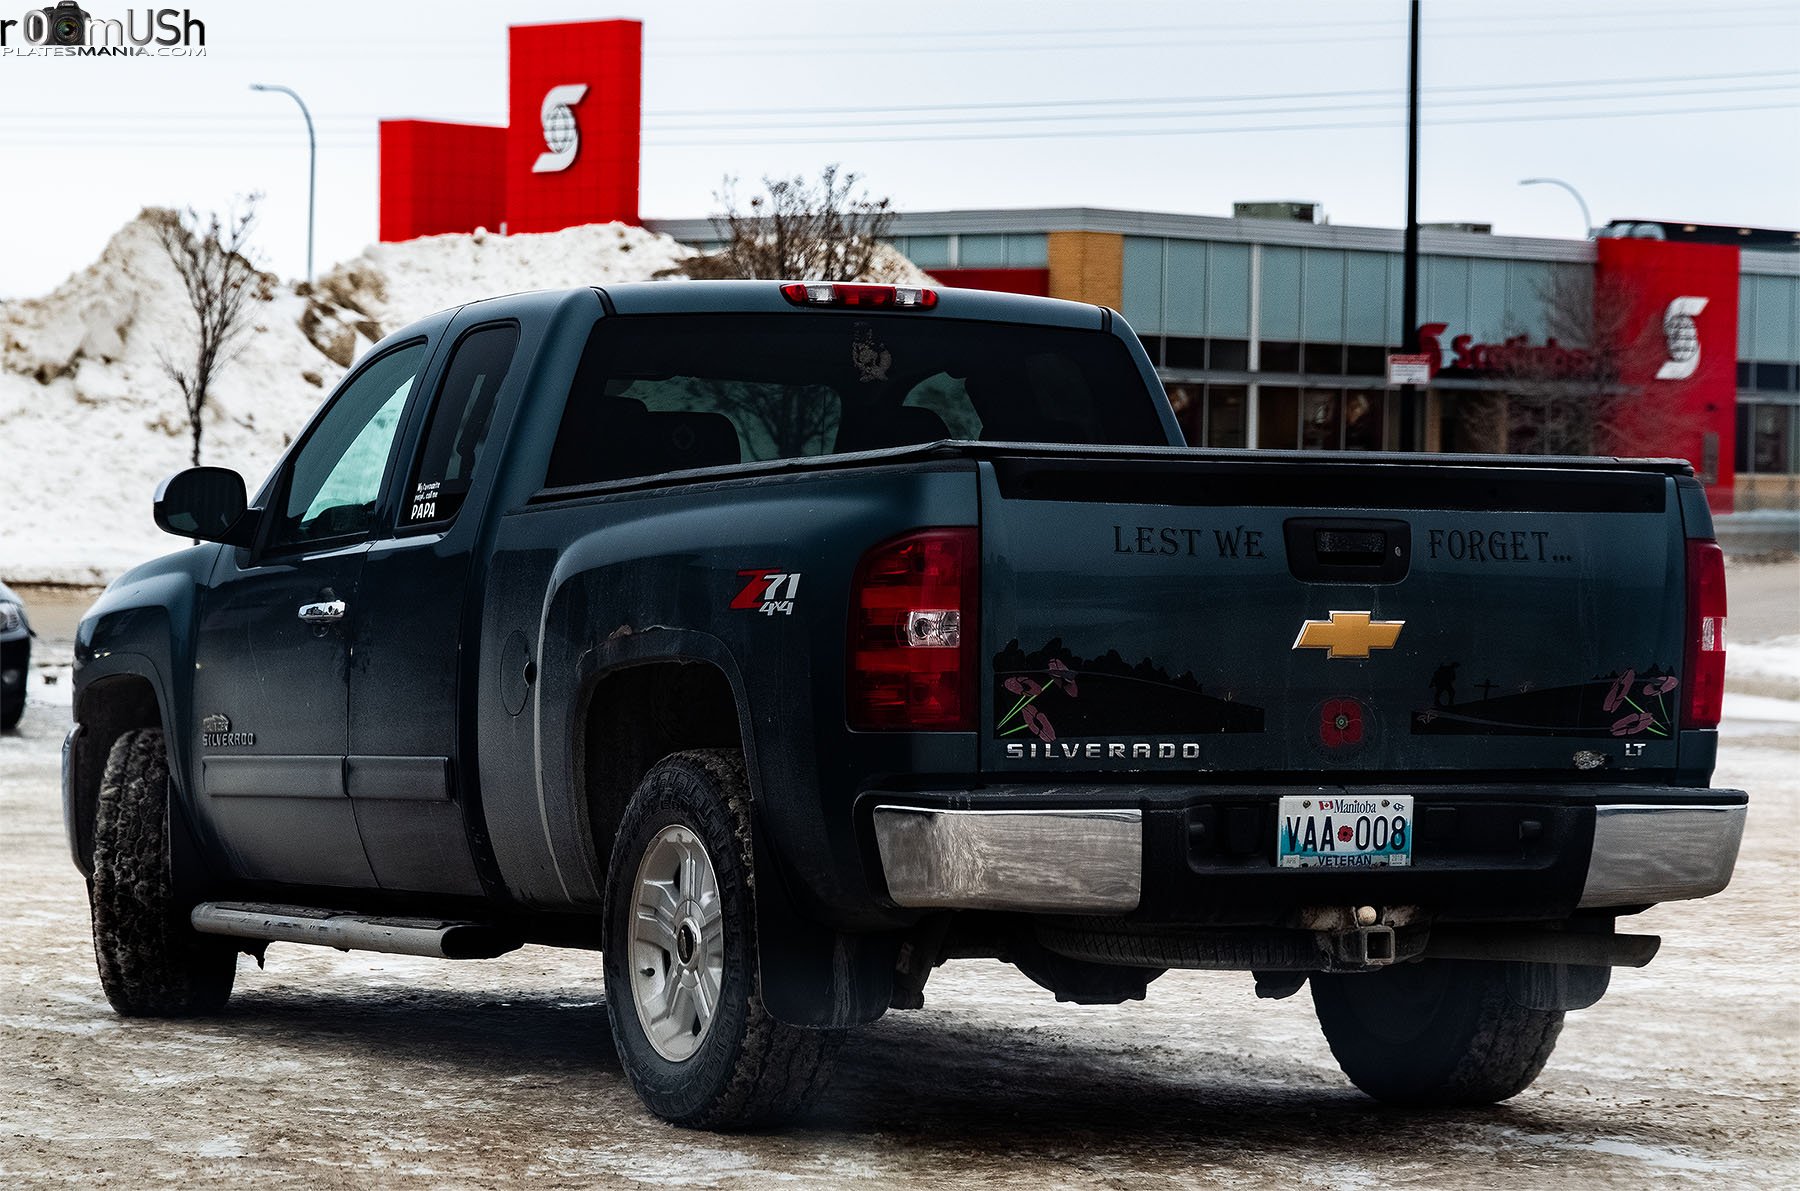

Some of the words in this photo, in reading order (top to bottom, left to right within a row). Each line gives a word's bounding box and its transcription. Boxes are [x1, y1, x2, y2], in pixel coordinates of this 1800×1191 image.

[411, 502, 435, 519] PAPA
[1112, 525, 1201, 557] LEST
[1213, 525, 1266, 559] WE
[728, 569, 801, 609] Z71
[202, 732, 254, 747] SILVERADO
[1006, 743, 1200, 759] SILVERADO
[1625, 743, 1647, 757] LT
[1334, 800, 1376, 813] Manitoba
[1286, 815, 1336, 852] VAA
[1355, 815, 1407, 851] 008
[1318, 855, 1372, 867] VETERAN
